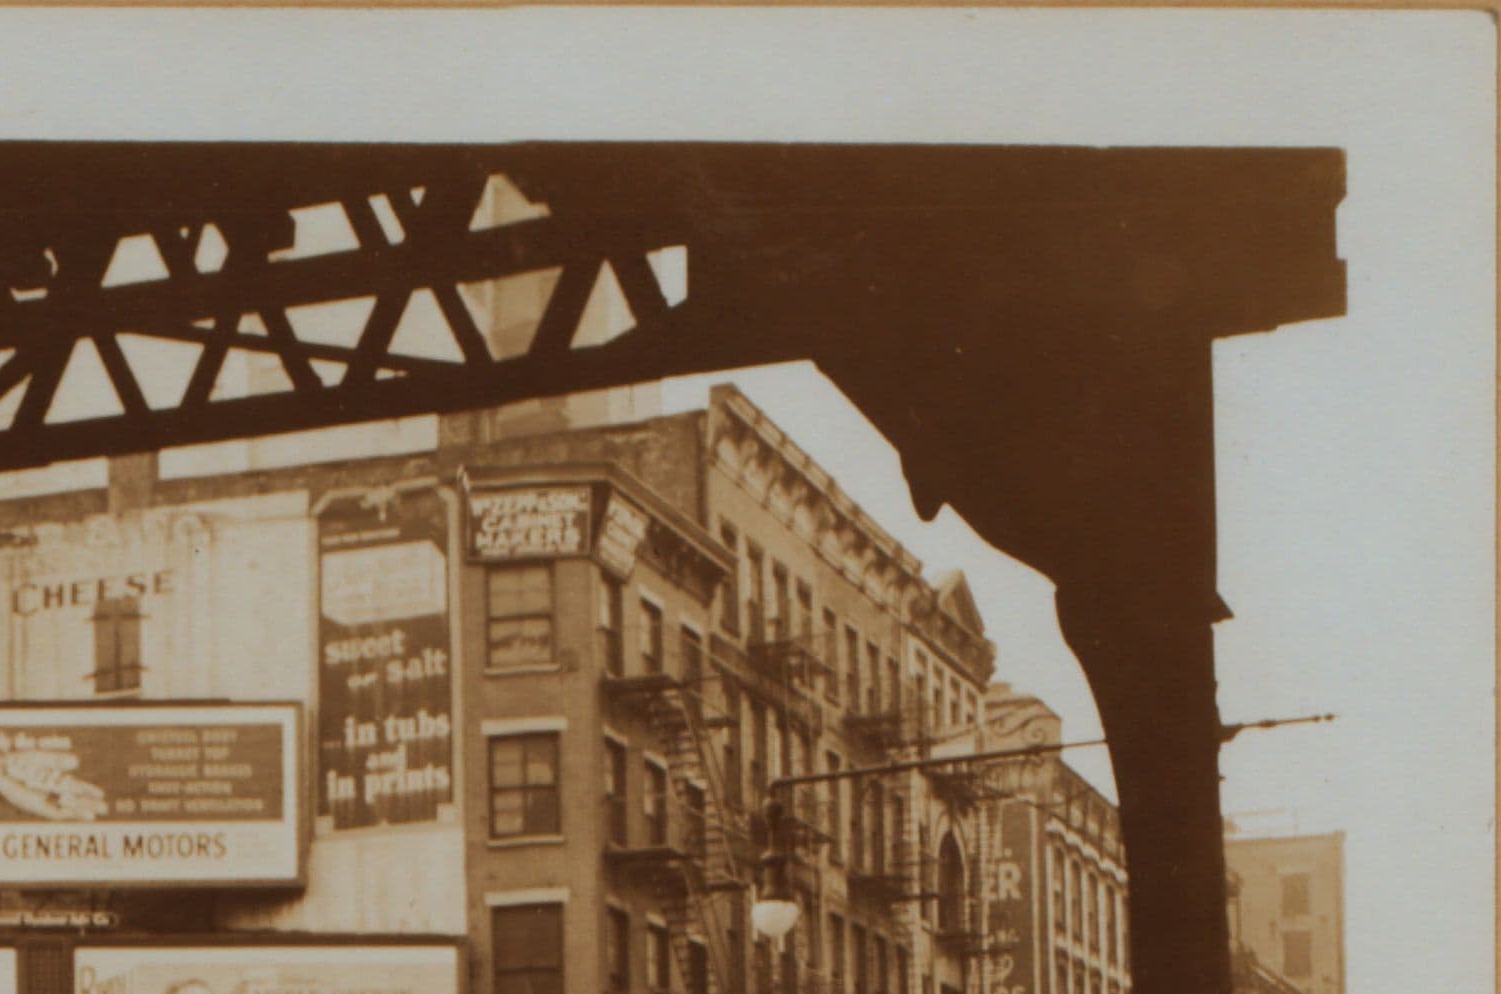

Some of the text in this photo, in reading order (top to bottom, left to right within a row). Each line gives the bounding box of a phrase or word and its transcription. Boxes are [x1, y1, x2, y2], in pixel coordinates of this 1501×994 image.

[12, 568, 175, 618] CHEESE
[387, 648, 447, 684] salt
[384, 708, 450, 743] tubs
[364, 762, 450, 804] prints
[2, 834, 228, 860] GENERAL MOTORS
